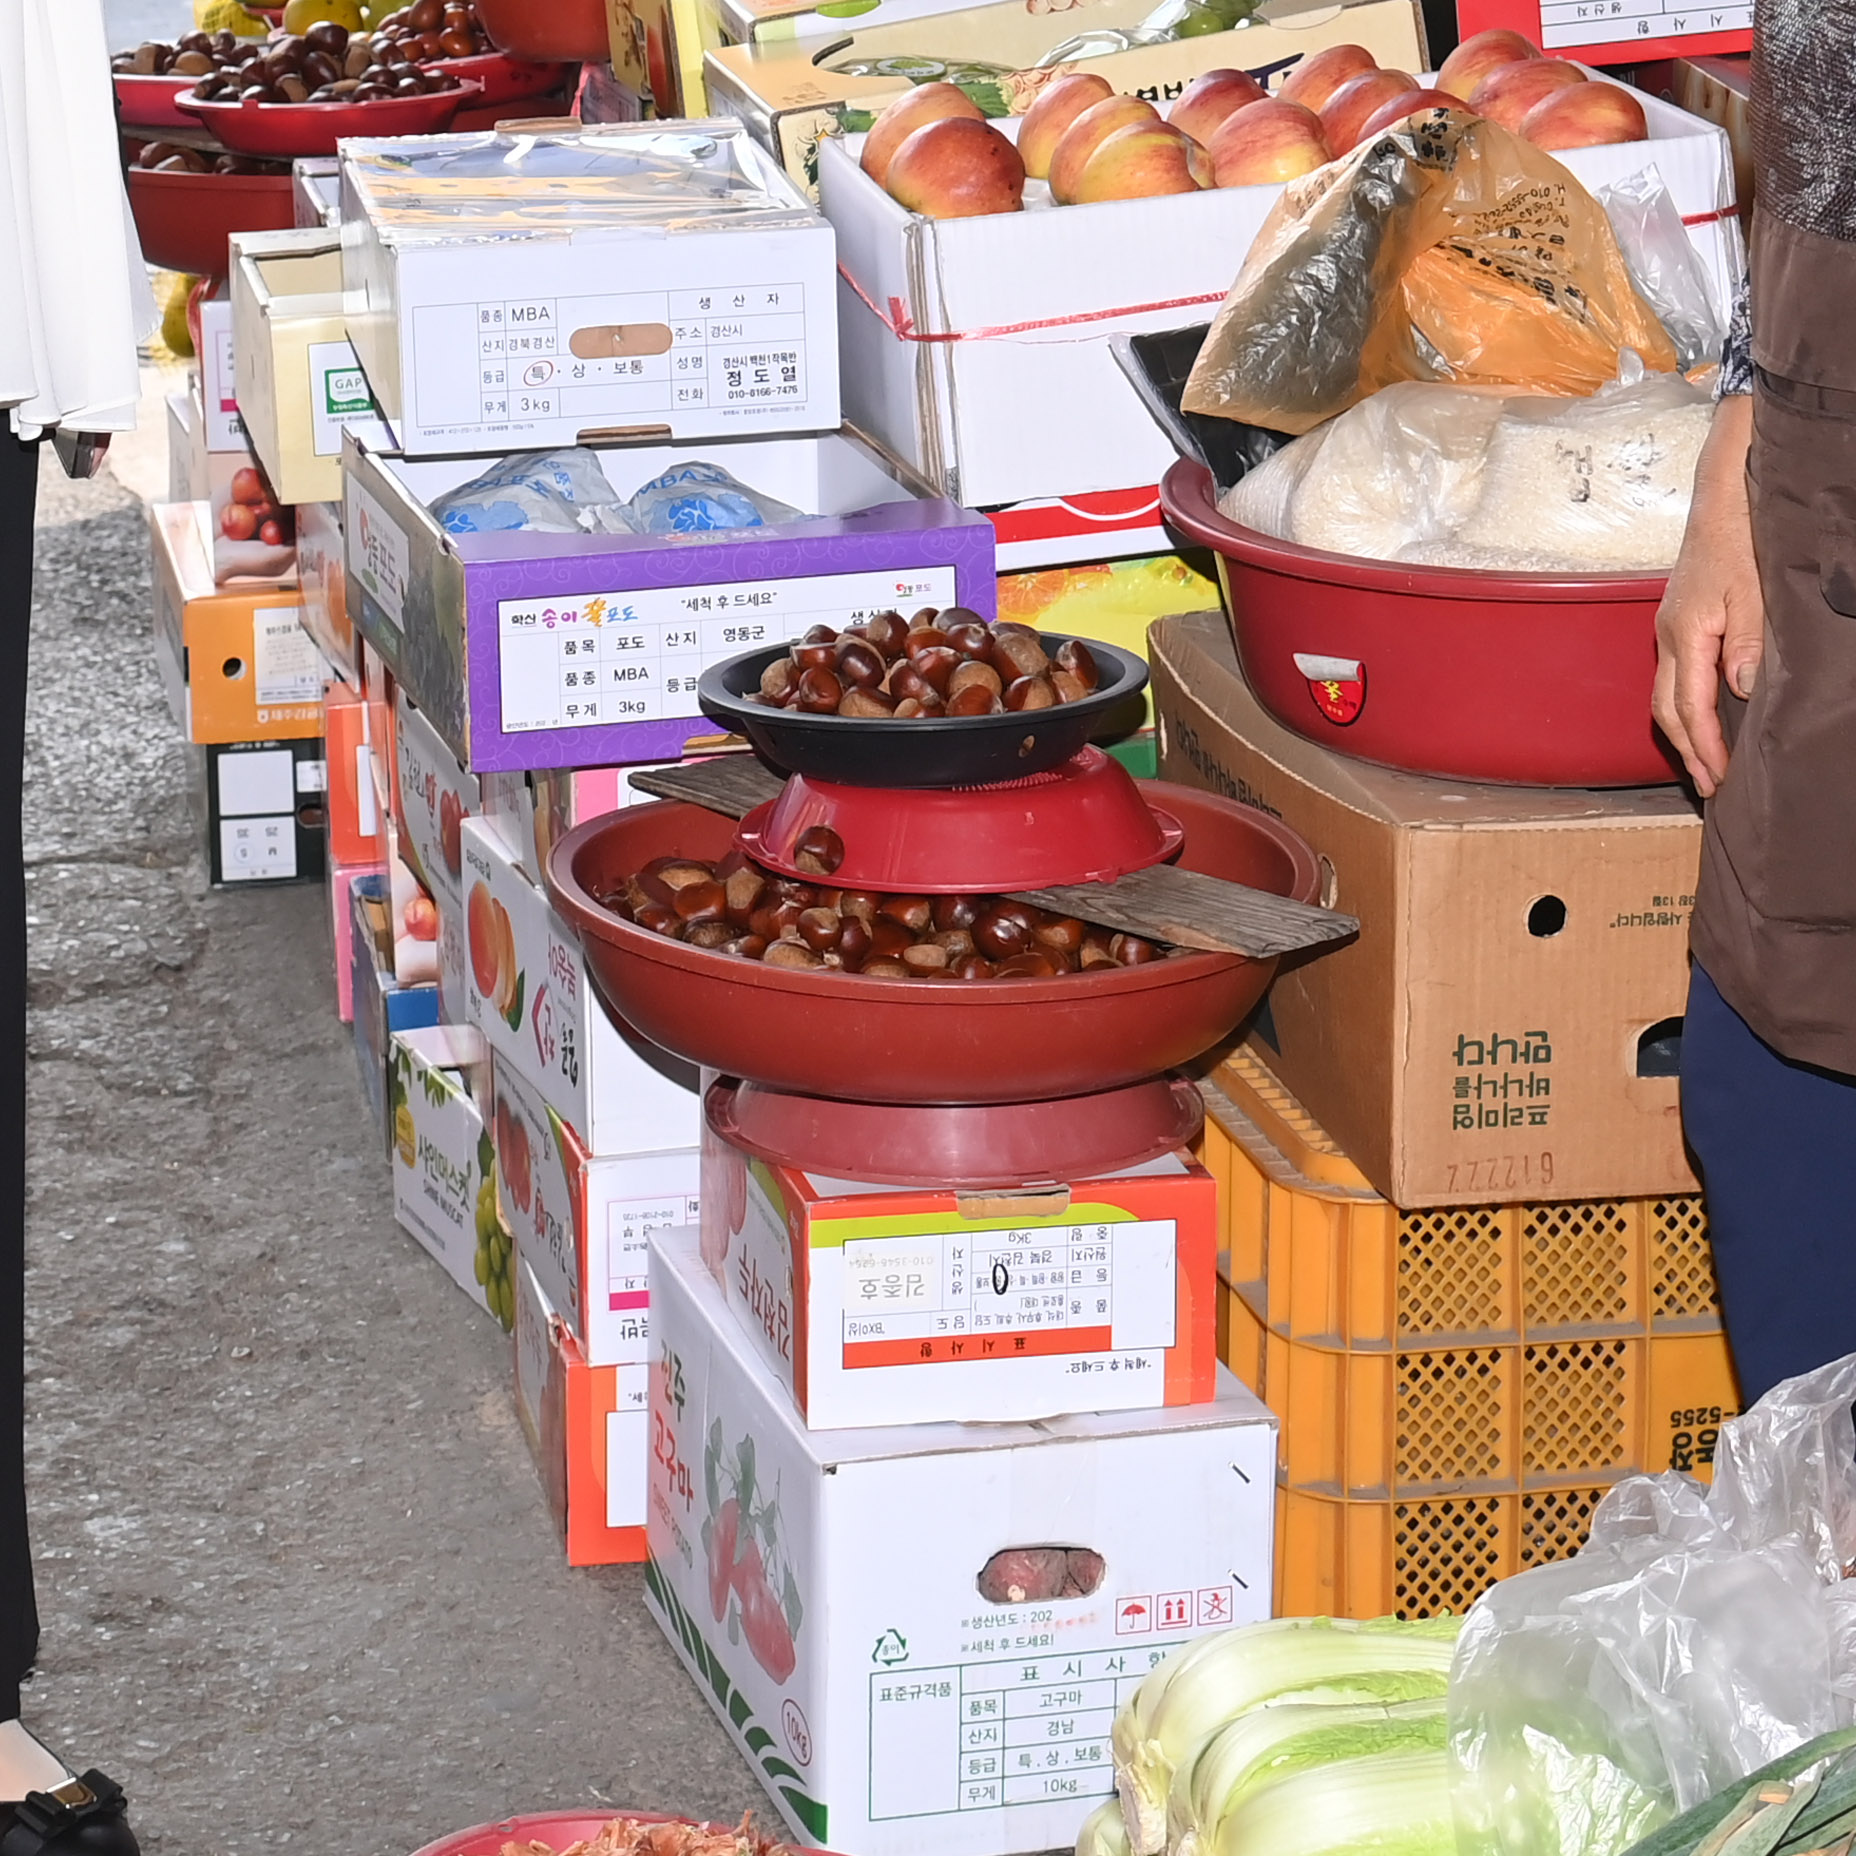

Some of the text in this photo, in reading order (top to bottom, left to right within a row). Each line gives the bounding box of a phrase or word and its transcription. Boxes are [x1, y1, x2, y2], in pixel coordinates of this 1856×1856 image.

[480, 306, 551, 324] 품종 MBA
[675, 324, 743, 341] 주소 경산시
[482, 339, 505, 353] 산지
[482, 360, 644, 384] 등급 특 상 보통
[676, 355, 703, 370] 성명
[334, 376, 363, 390] GAP
[726, 365, 797, 388] 정도열
[677, 387, 704, 402] 전화
[484, 397, 551, 415] 무게 3kg
[716, 594, 730, 610] 후
[511, 613, 537, 626] 학산
[564, 626, 766, 655] 품목 포도 산지 영동군
[565, 666, 699, 693] 품종 MBA 등급
[565, 700, 647, 719] 무게 3kg
[1453, 1030, 1552, 1067] 만나다
[1453, 1071, 1551, 1101] 바나나를
[1453, 1101, 1552, 1132] 프리미엄
[1007, 1226, 1108, 1246] 중량 3Kg
[987, 1247, 1107, 1269] 원산지 경북 김천시
[1070, 1269, 1108, 1283] 등급
[858, 1274, 927, 1302] 김종호
[738, 1242, 791, 1364] 김천자두
[1070, 1298, 1108, 1315] 품종
[936, 1314, 966, 1332] 당도
[1109, 1357, 1121, 1372] 후
[653, 1409, 694, 1513] 고구마
[1029, 1609, 1053, 1624] 202
[999, 1636, 1011, 1652] 후
[879, 1681, 953, 1703] 표준규격품
[968, 1690, 1083, 1717] 품목 고구마
[785, 1709, 809, 1760] 10kg
[968, 1719, 1075, 1745] 산지 경남
[968, 1757, 997, 1774] 등급
[1073, 1745, 1102, 1763] 보통
[967, 1778, 1078, 1802] 무게 10kg
